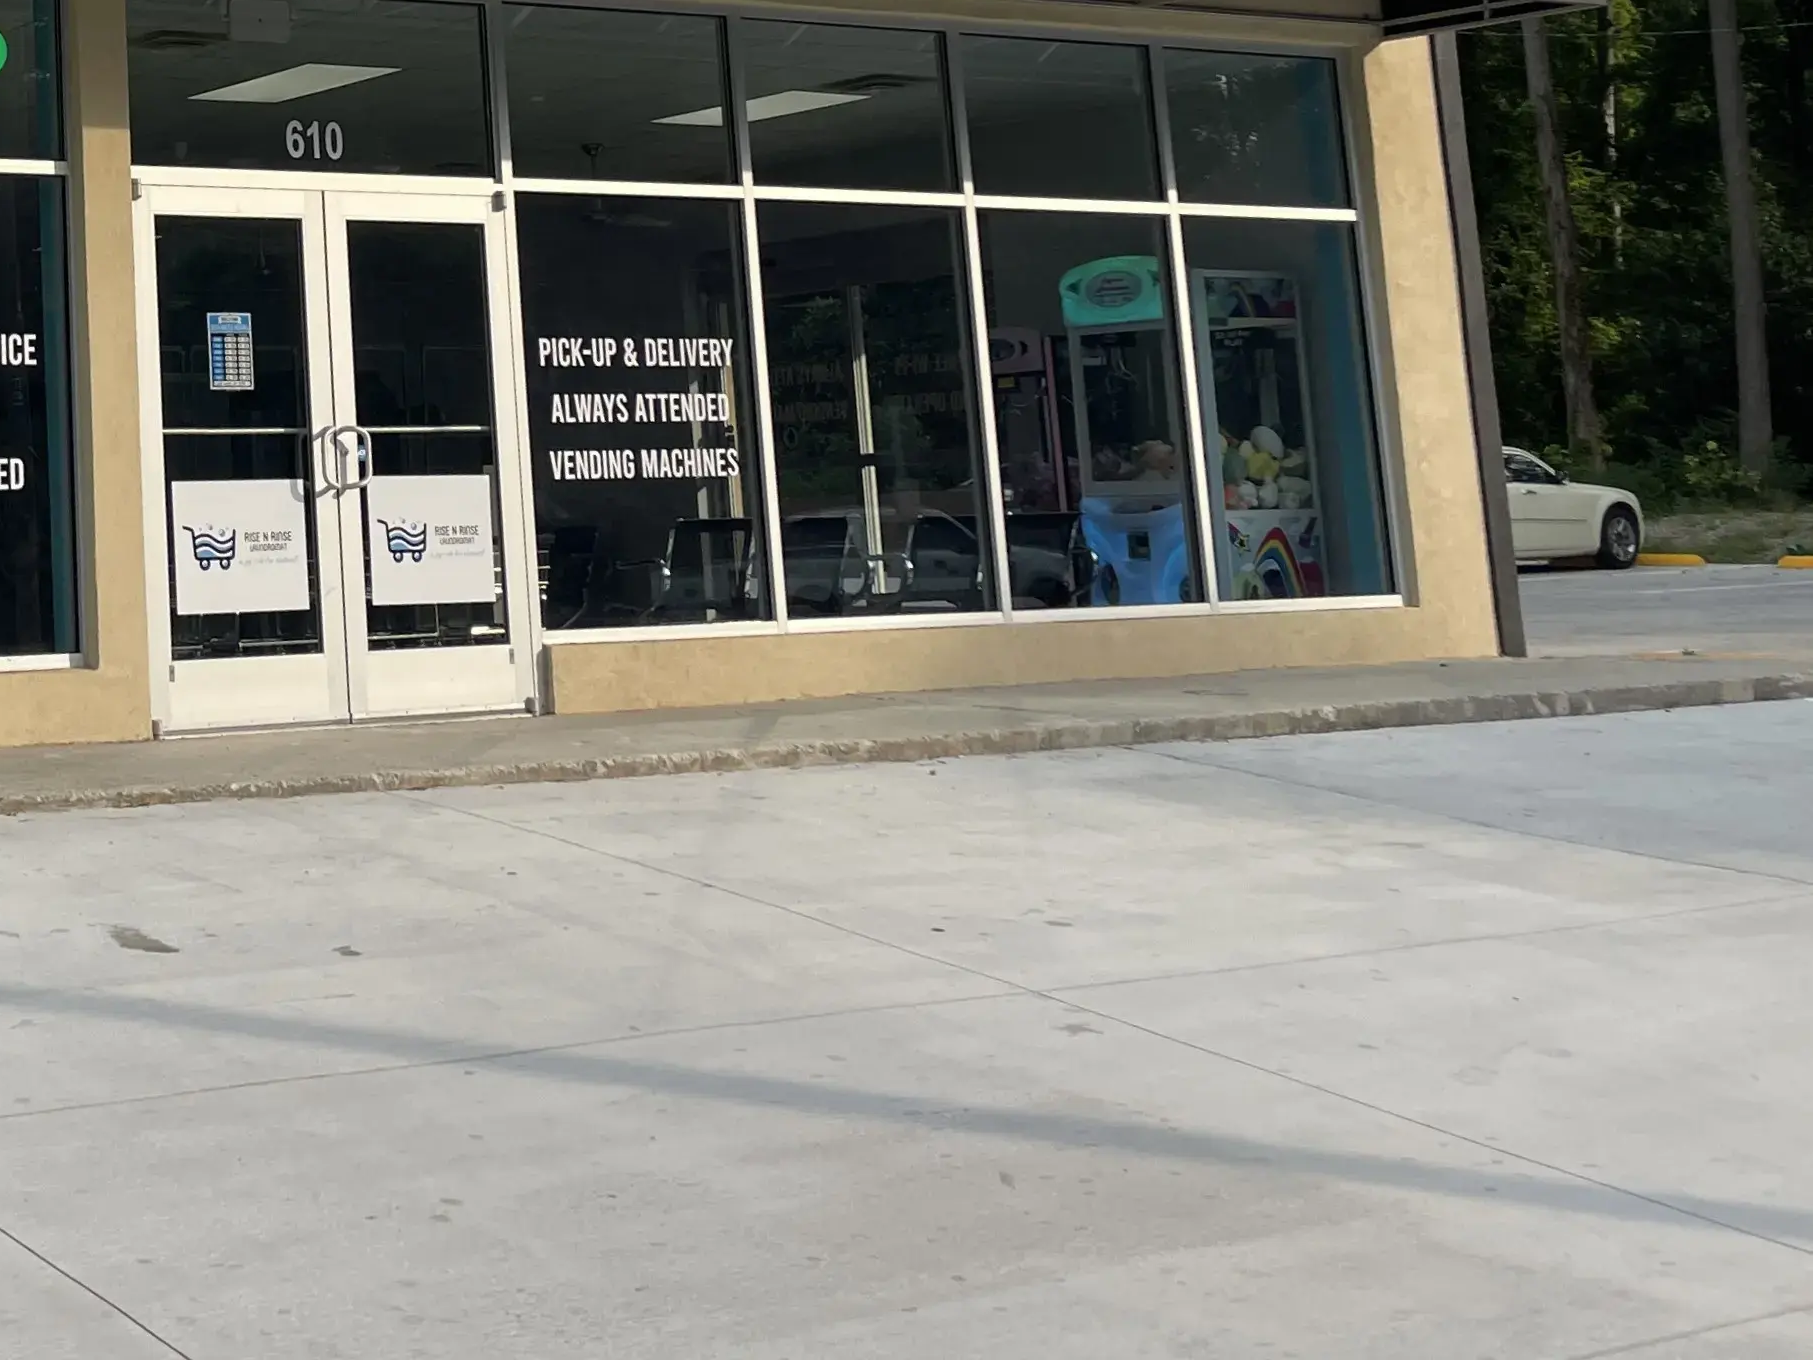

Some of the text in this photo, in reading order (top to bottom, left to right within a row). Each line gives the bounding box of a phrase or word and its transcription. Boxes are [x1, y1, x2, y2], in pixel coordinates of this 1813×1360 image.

[285, 120, 344, 160] 610
[538, 337, 734, 367] PICK-UP & DELIVERY
[551, 393, 729, 423] ALWAYS ATTENDED
[549, 448, 739, 480] VENDING MACHINES
[244, 531, 261, 543] RISE
